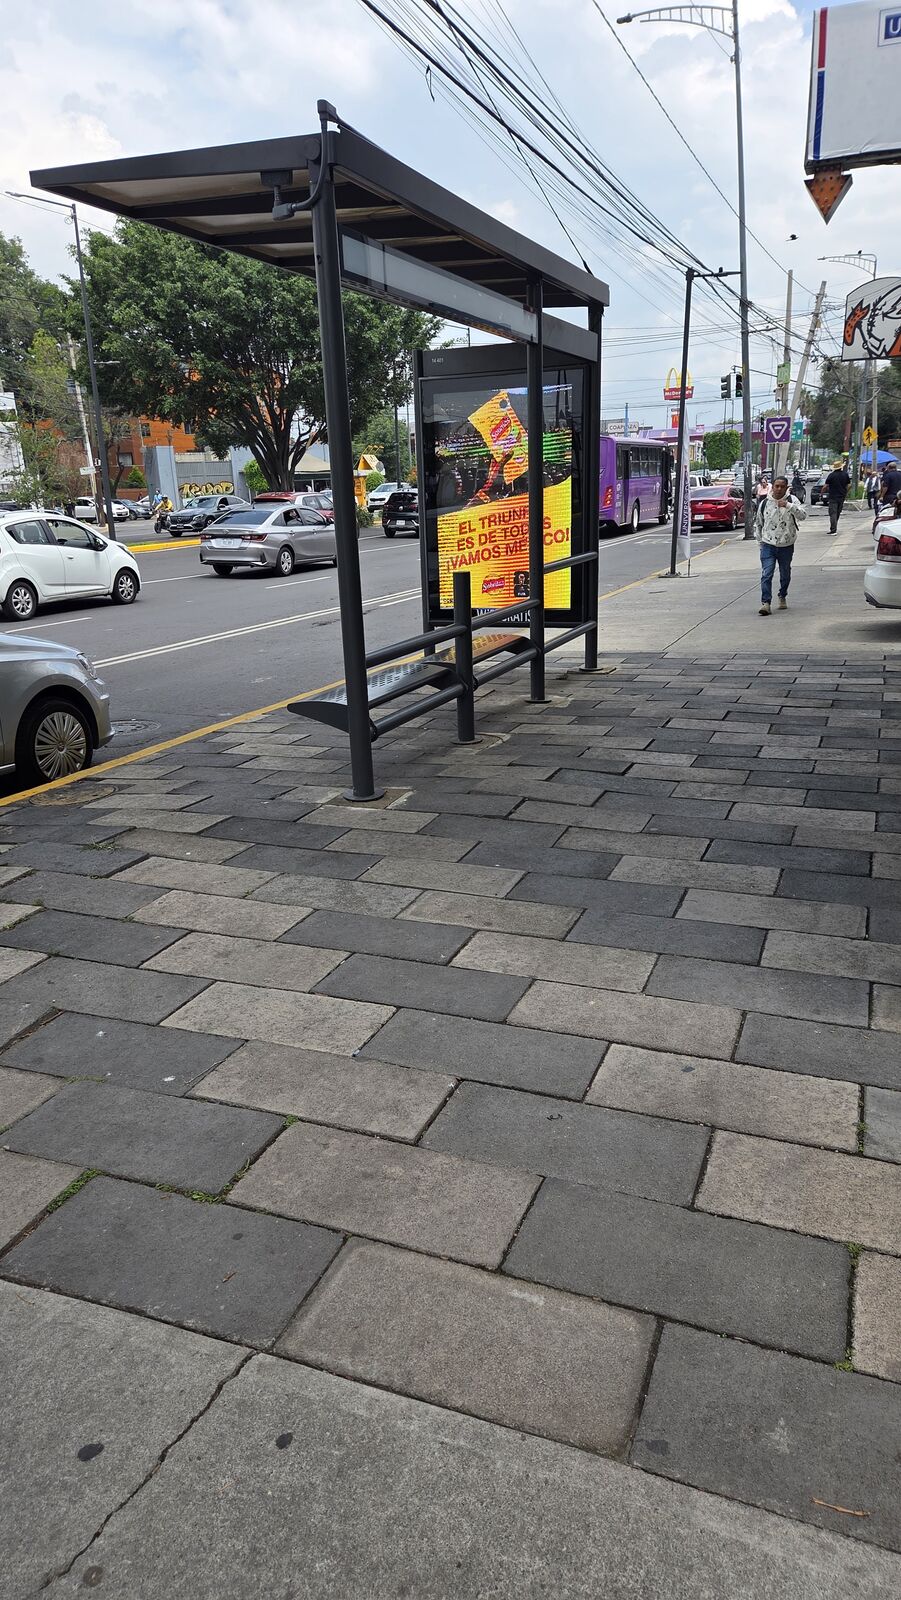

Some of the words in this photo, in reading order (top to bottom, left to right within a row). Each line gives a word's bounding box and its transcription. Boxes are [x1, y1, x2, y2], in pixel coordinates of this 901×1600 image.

[457, 537, 474, 552] ES
[478, 530, 497, 546] DE
[503, 516, 551, 540] TODS
[458, 520, 476, 535] EL
[479, 506, 529, 530] TRIUNF
[506, 528, 569, 556] MÉCO!
